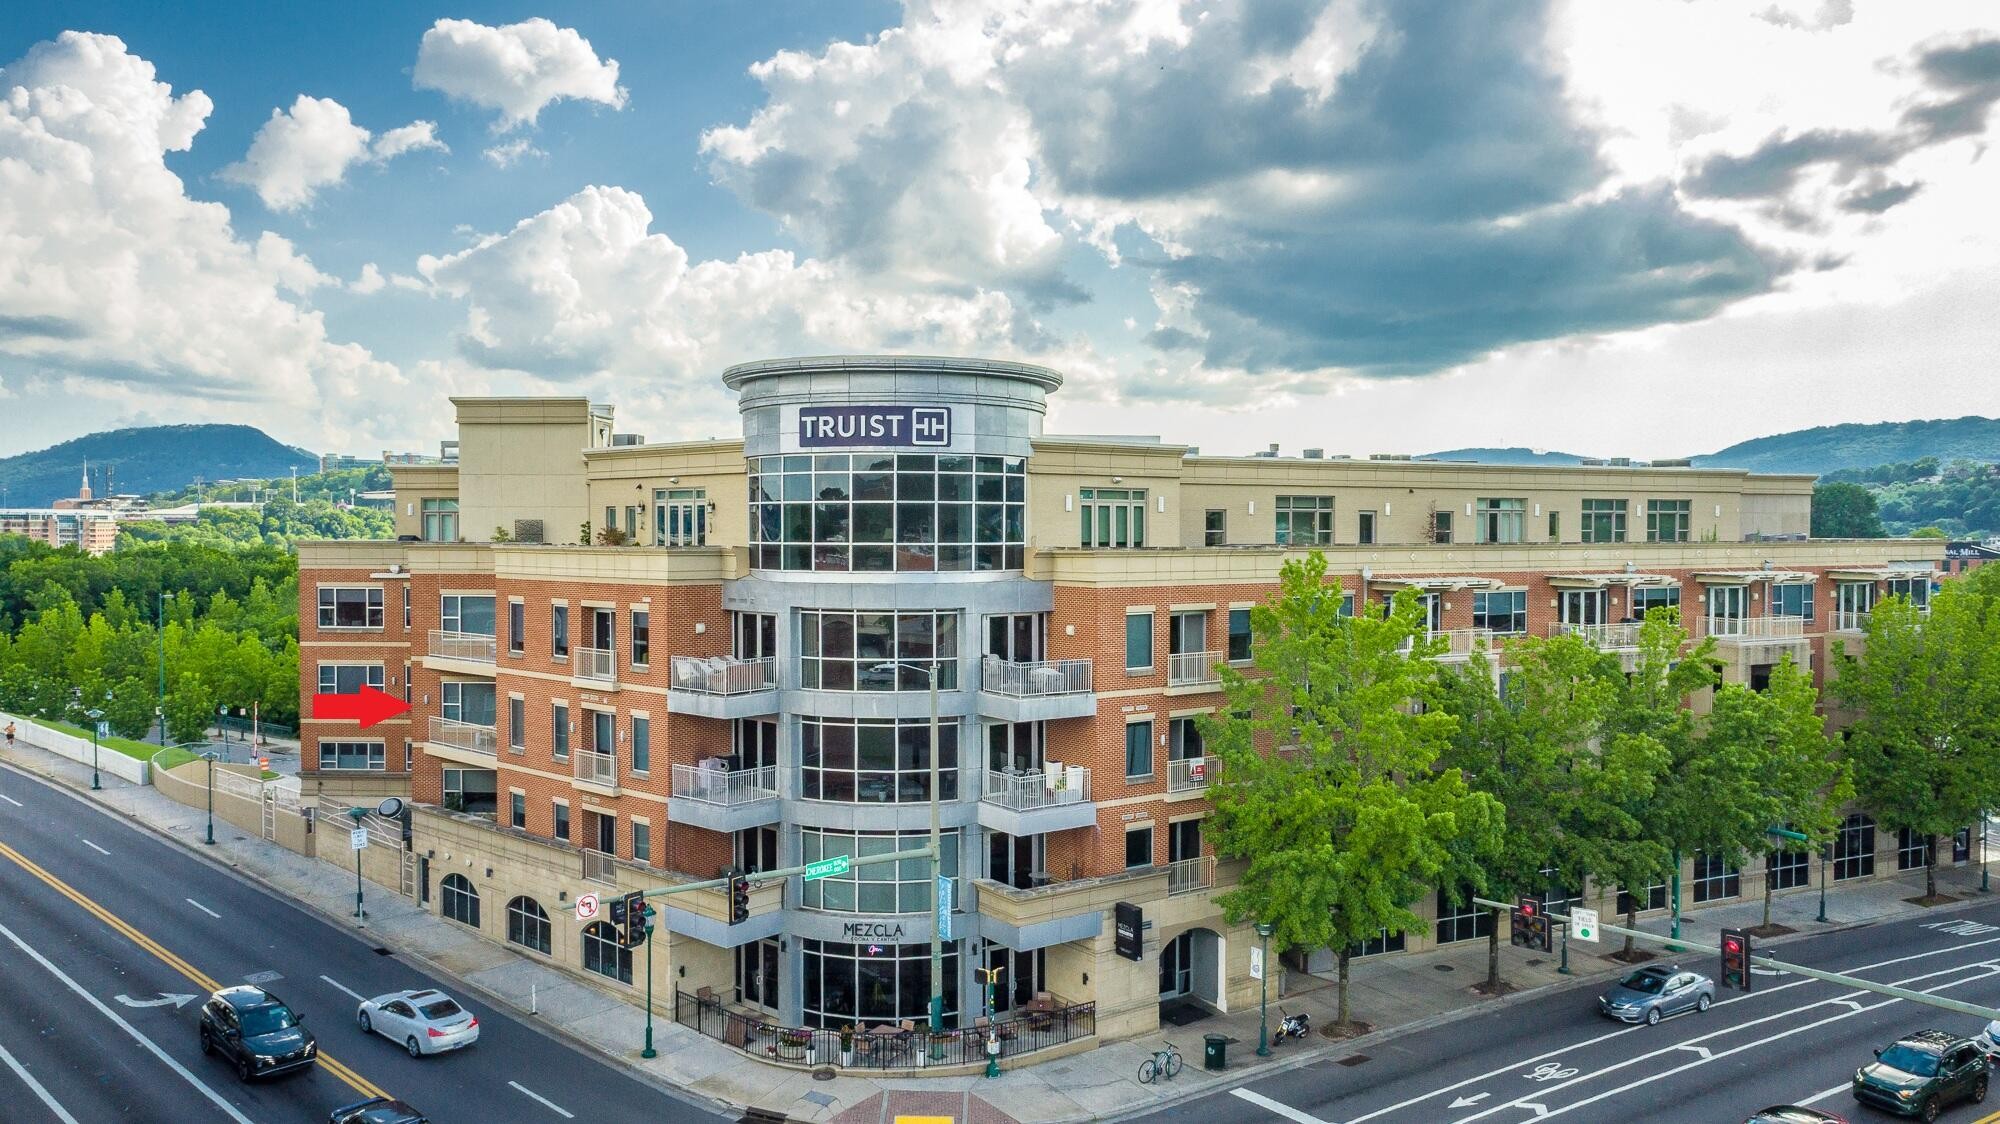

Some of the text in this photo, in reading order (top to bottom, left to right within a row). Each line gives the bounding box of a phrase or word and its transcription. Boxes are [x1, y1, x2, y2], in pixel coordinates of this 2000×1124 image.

[801, 415, 904, 438] TRUIST
[807, 863, 833, 876] CHEROKEE
[843, 922, 904, 937] MEZCLA
